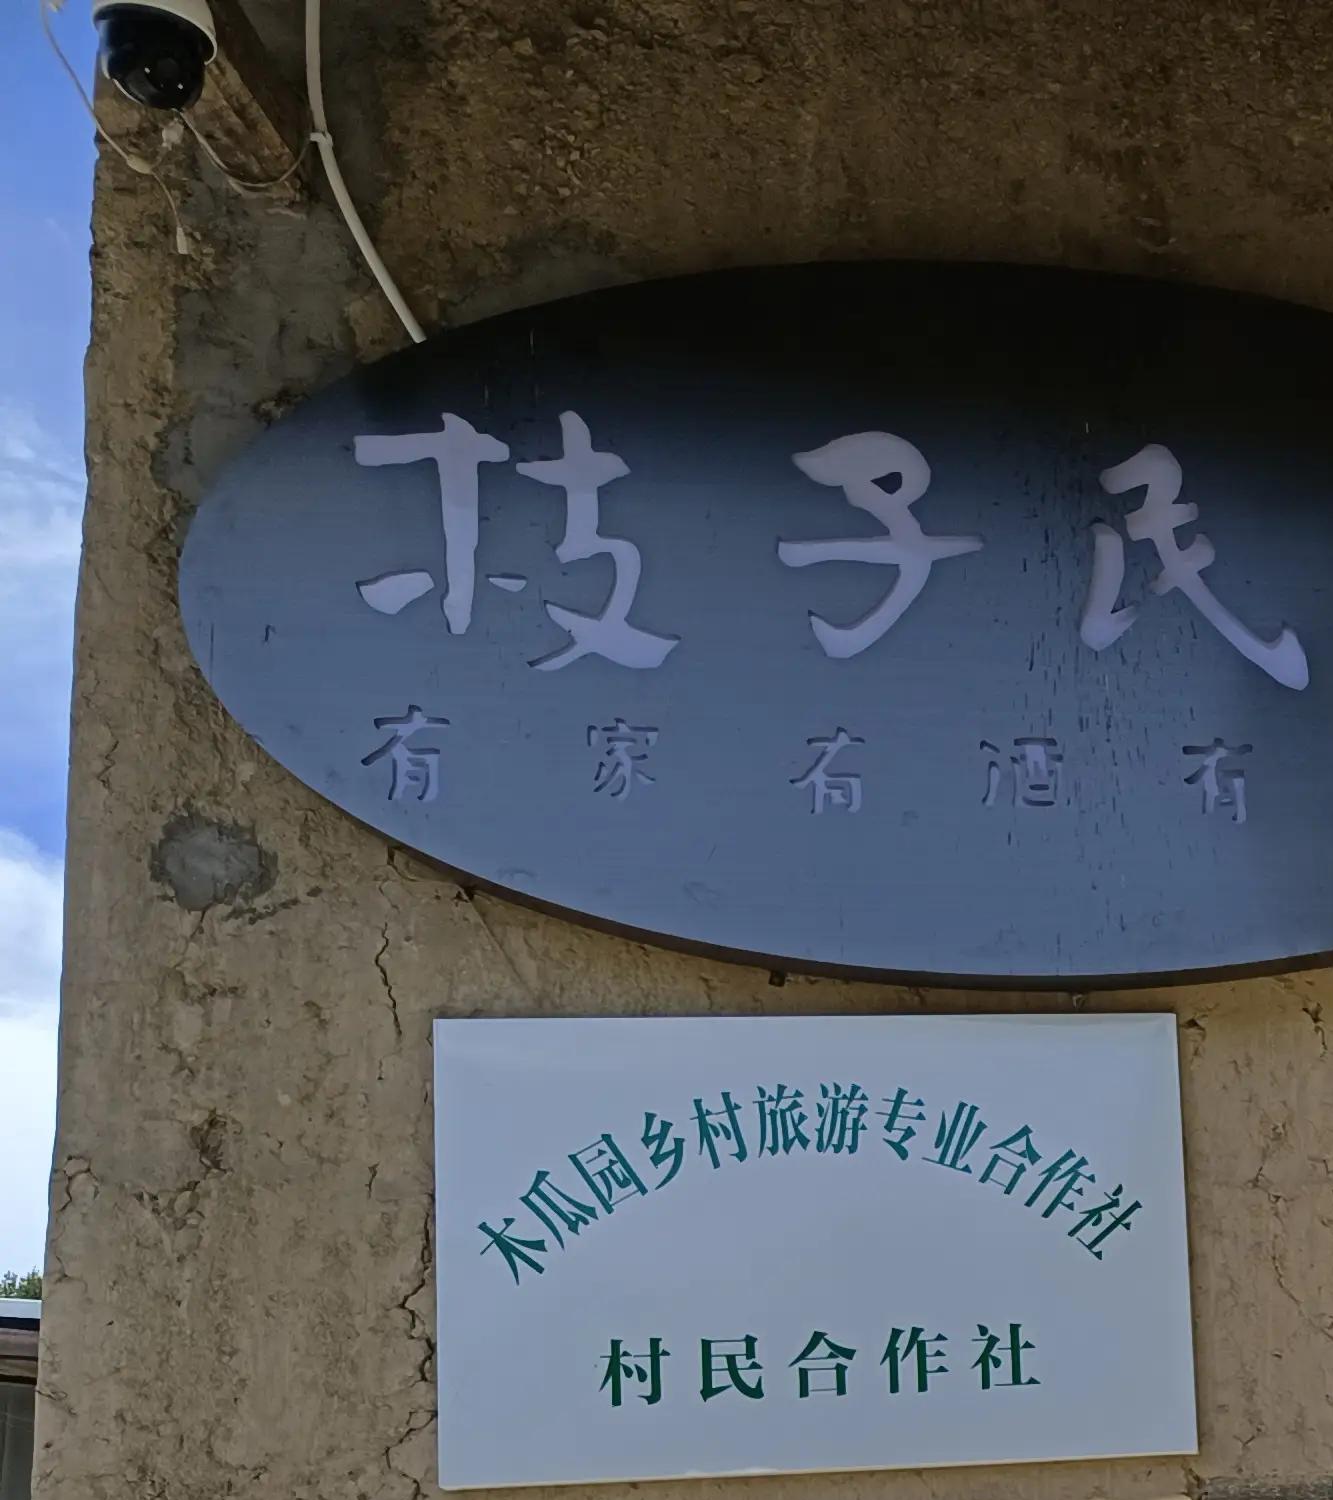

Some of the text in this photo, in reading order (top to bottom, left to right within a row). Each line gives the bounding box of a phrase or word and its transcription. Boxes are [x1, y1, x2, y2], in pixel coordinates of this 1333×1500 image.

[477, 1081, 1143, 1286] 木瓜园乡村旅游专业合作社
[600, 1322, 1041, 1407] 村民合作社
